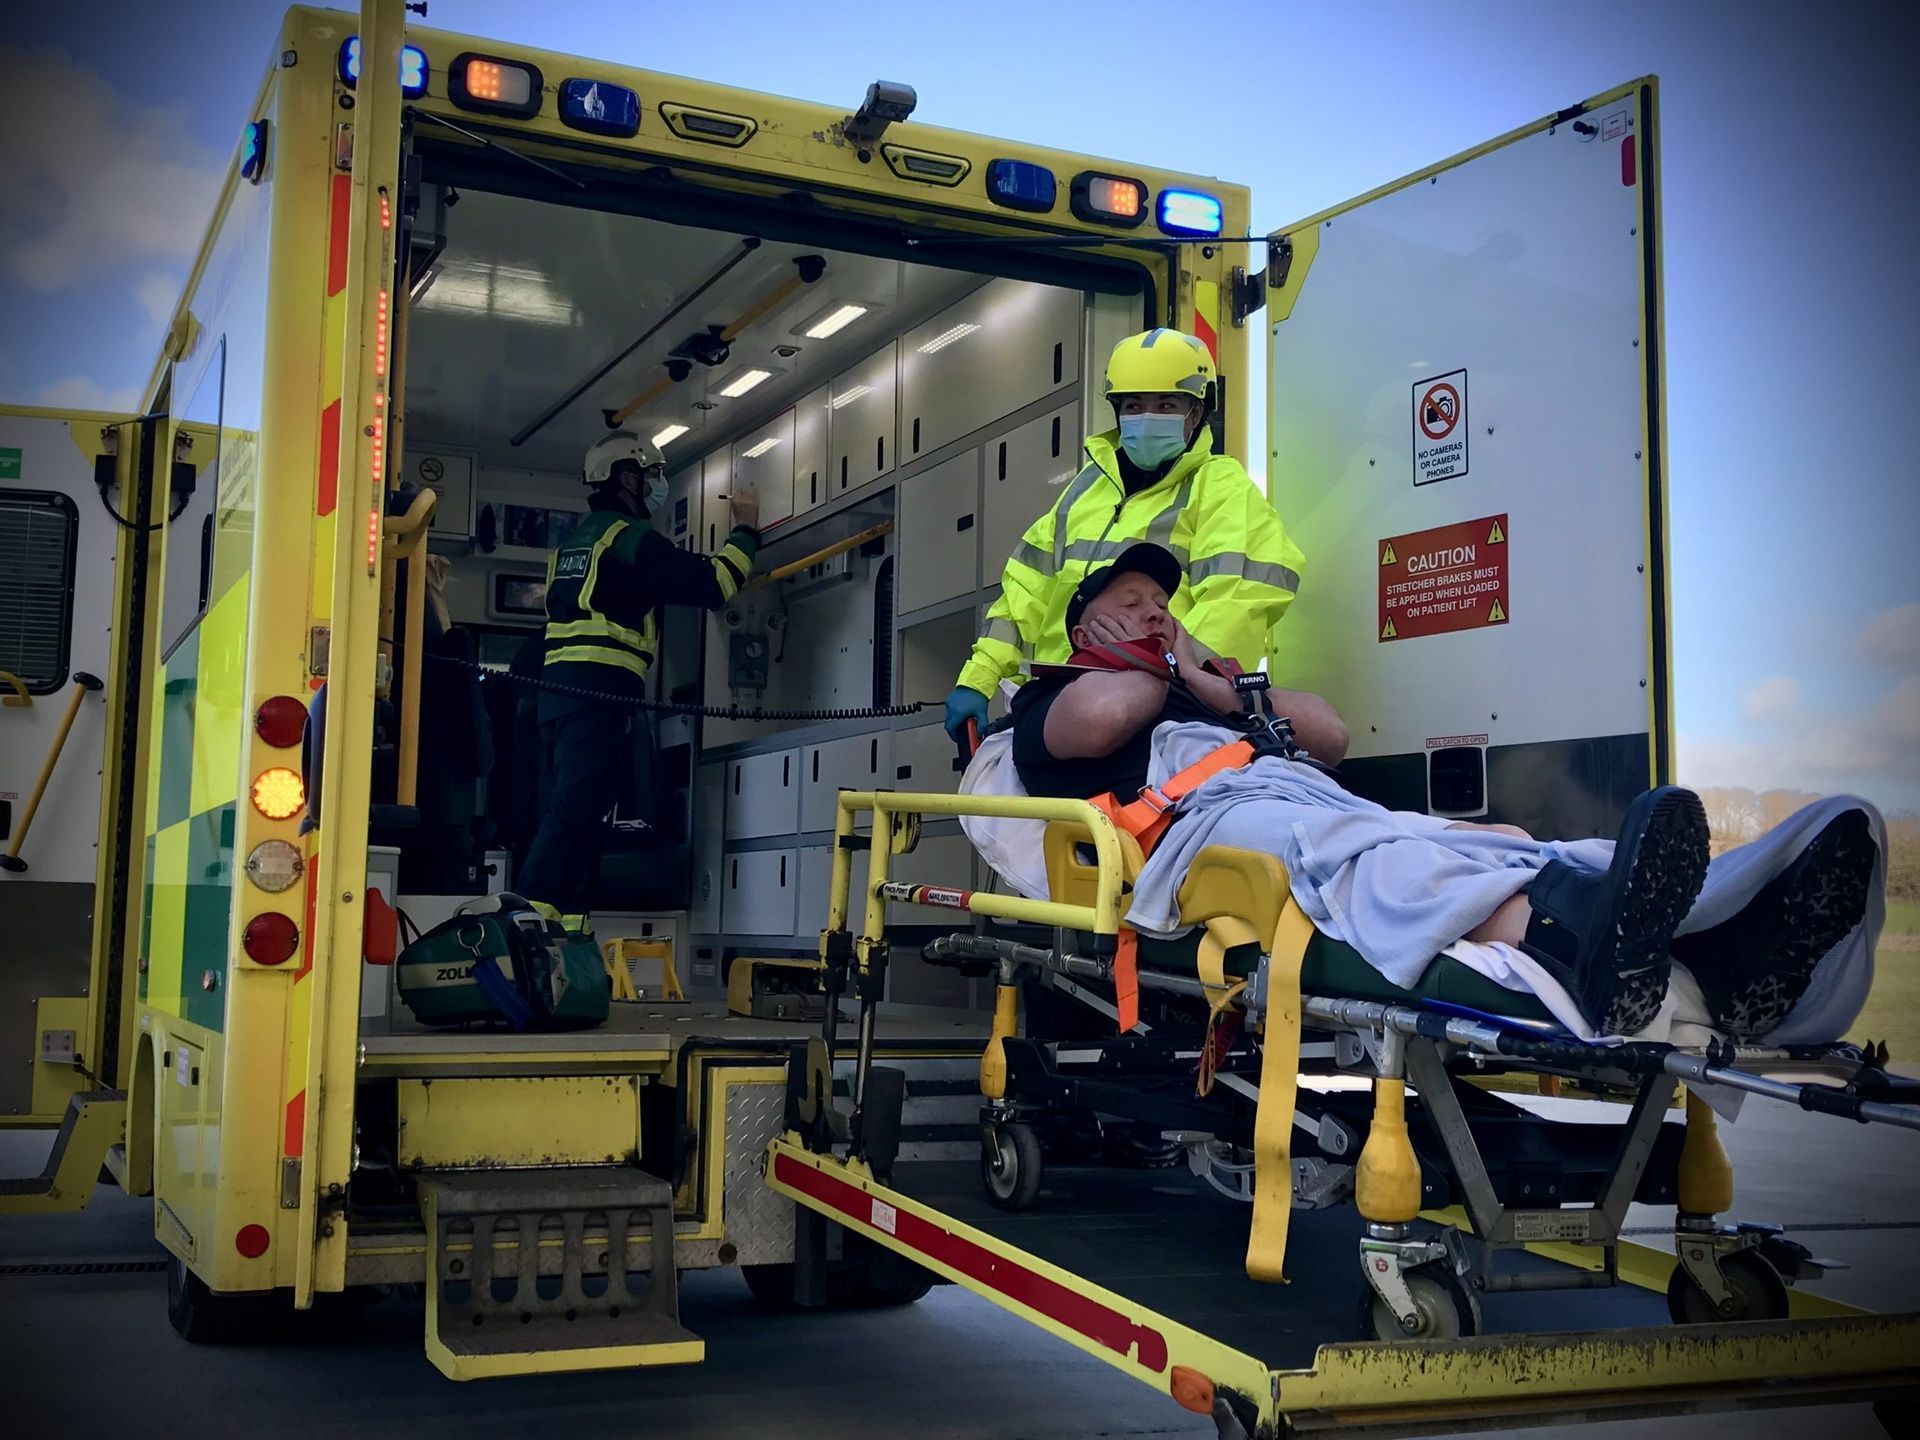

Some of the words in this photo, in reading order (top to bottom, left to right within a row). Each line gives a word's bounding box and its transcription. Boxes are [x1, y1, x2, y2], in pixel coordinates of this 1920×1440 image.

[1418, 451, 1428, 459] NO
[1430, 441, 1463, 457] CAMERAS
[1420, 461, 1430, 469] OR
[1432, 453, 1461, 467] CAMERA
[1426, 465, 1455, 478] PHONES
[1407, 544, 1476, 572] CAUTION
[1386, 578, 1436, 595] STRETCHER
[1437, 571, 1472, 586] BRAKES
[1474, 566, 1499, 579] MUST
[1386, 599, 1397, 608] BE
[1398, 592, 1434, 606] APPLIED
[1436, 587, 1461, 600] WHEN
[1463, 580, 1500, 594] LOADED
[1407, 606, 1420, 618] ON
[1421, 601, 1456, 615] PATIENT
[1459, 597, 1478, 609] LIFT
[1239, 675, 1265, 685] FERNO
